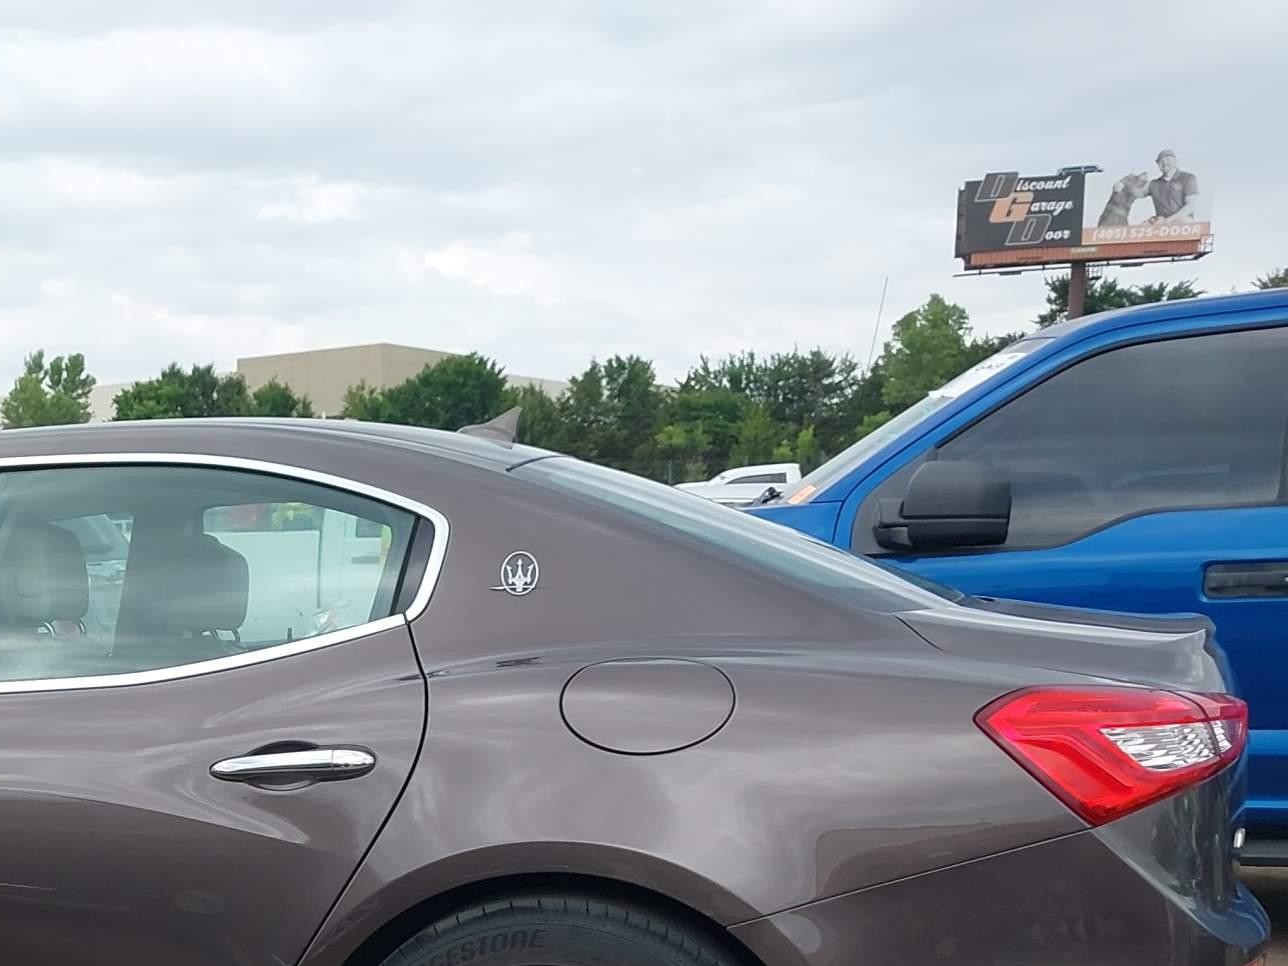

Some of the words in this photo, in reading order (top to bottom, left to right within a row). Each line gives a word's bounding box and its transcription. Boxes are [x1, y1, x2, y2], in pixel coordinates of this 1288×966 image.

[974, 171, 1072, 202] Discount
[989, 191, 1074, 223] Garage
[1004, 213, 1072, 246] Door
